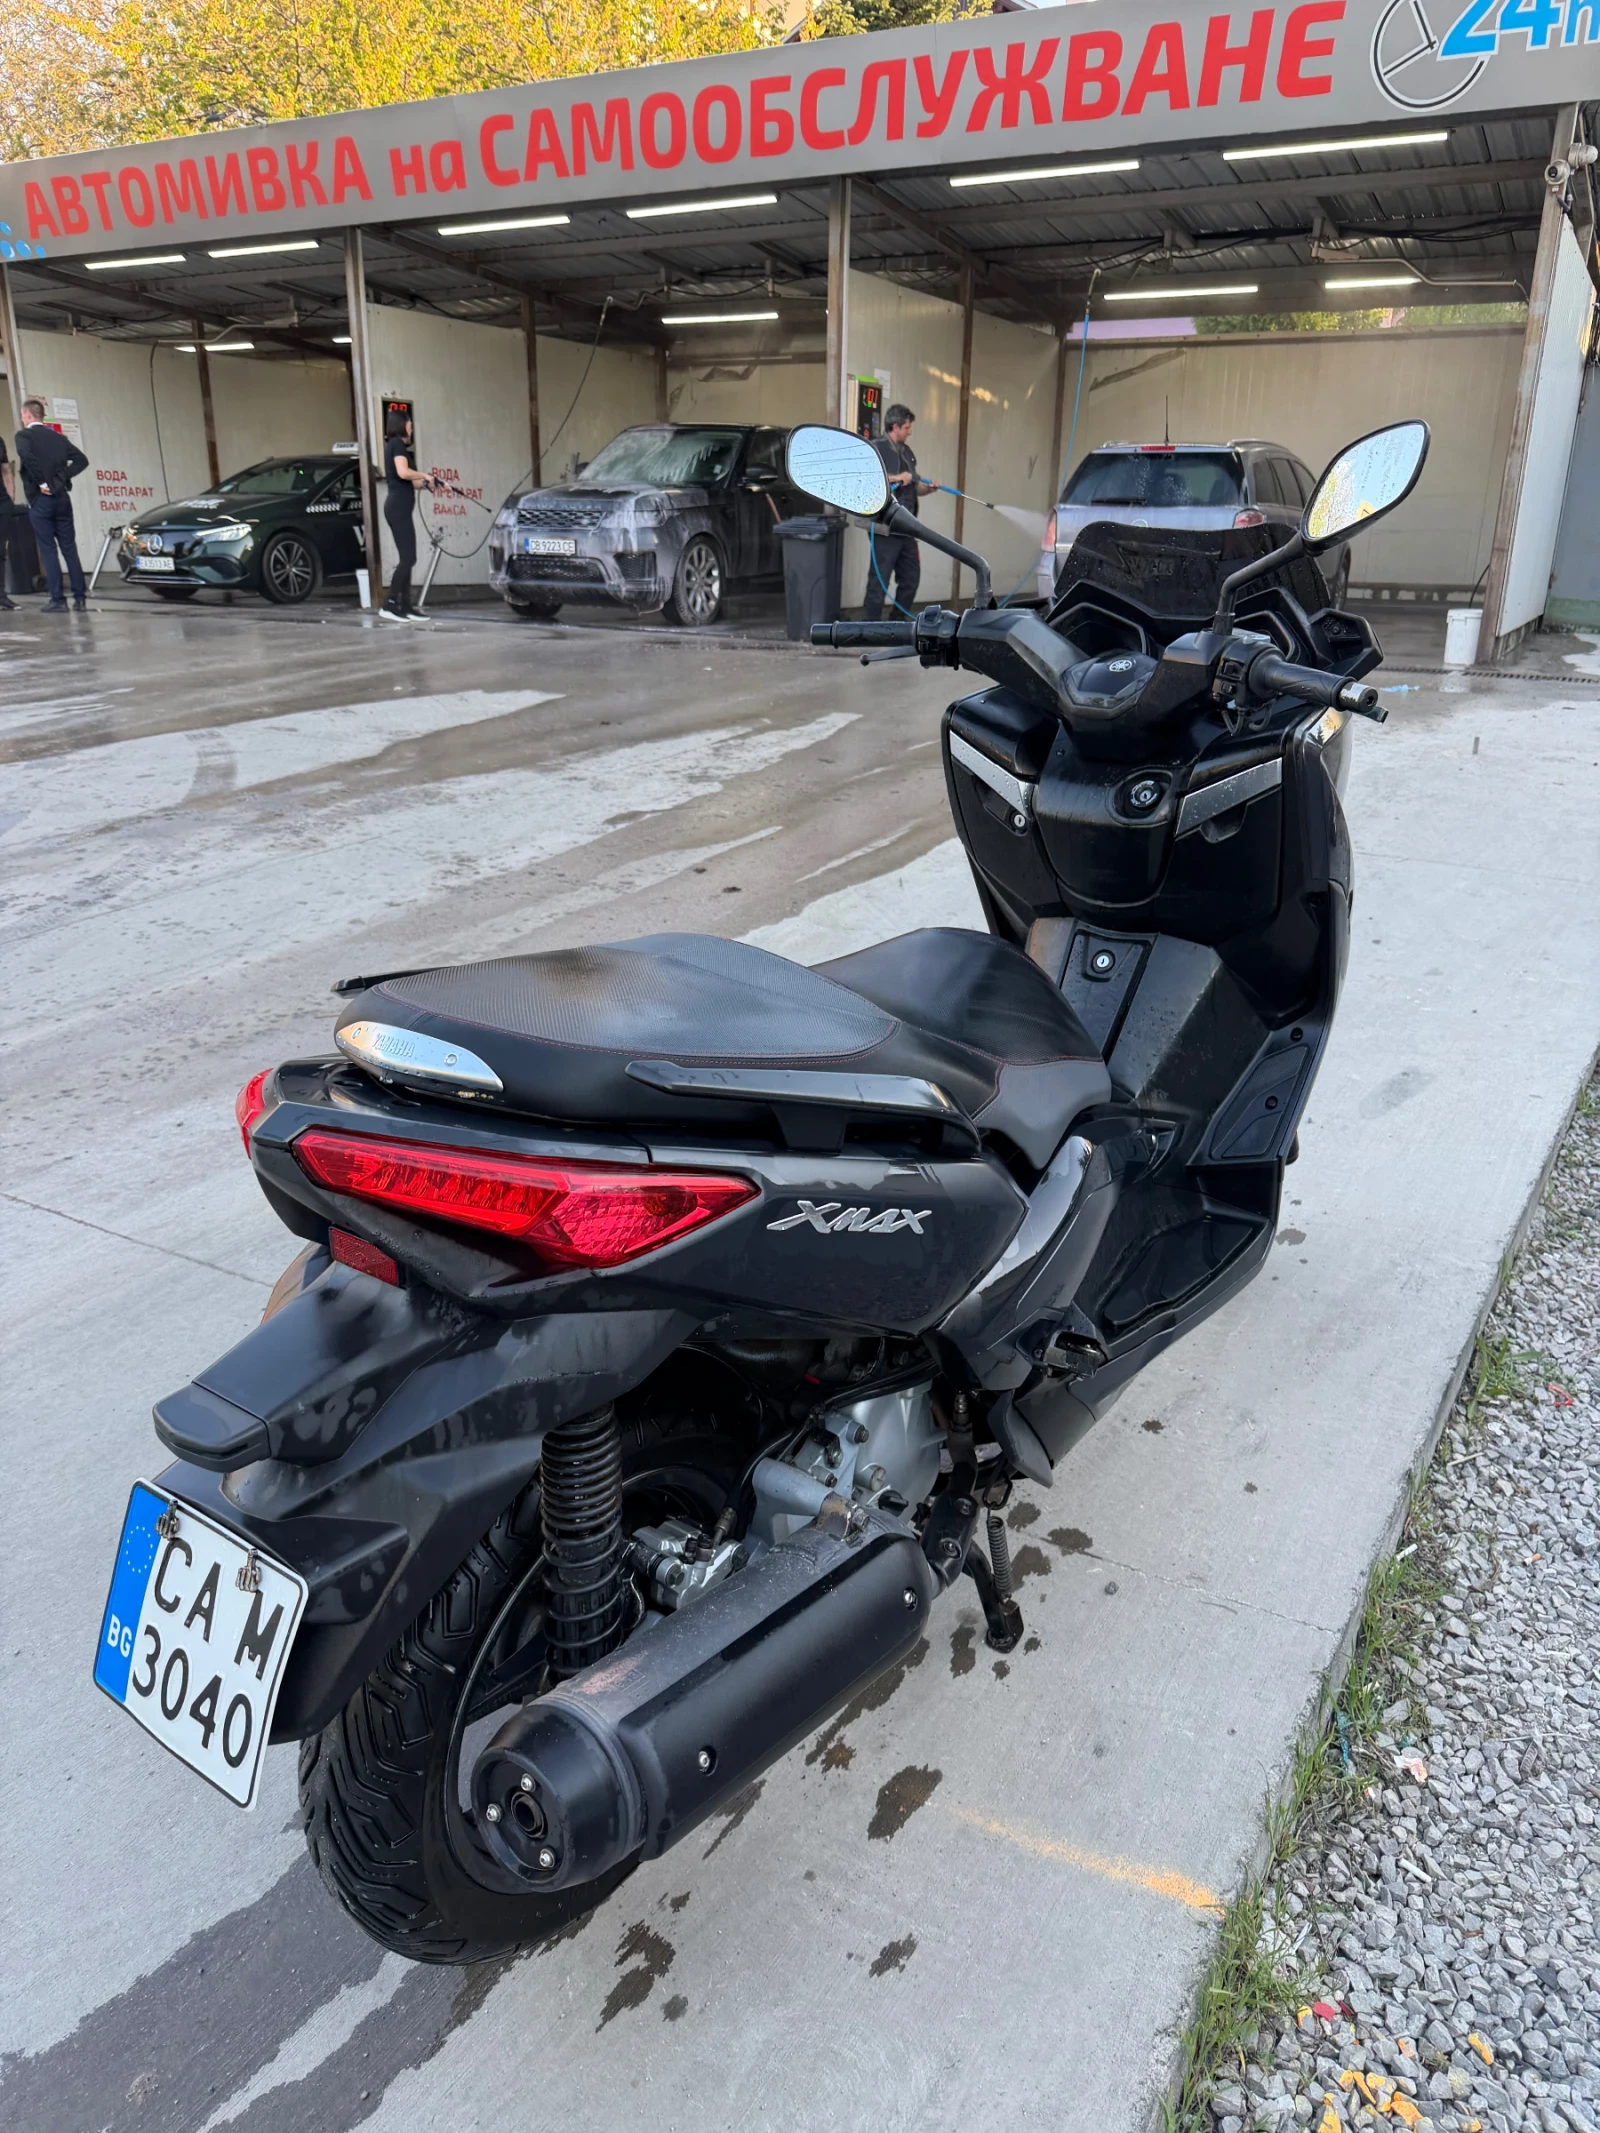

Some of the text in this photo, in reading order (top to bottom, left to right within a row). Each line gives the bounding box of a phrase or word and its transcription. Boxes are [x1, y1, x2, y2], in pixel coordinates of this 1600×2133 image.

[24, 0, 1346, 240] АВТОМИВКА на САМООБСЛУЖВАНЕ
[96, 470, 128, 482] ВОДА
[431, 467, 460, 481] ВОДА
[98, 486, 153, 497] ПРЕПАРАТ
[100, 501, 137, 512] ВАКСА
[433, 503, 467, 516] ВАКСА
[542, 541, 561, 551] 9223
[372, 1033, 416, 1058] YAMAHA
[766, 1200, 932, 1234] XMAX
[107, 1613, 133, 1658] BG
[132, 1624, 253, 1769] 3040
